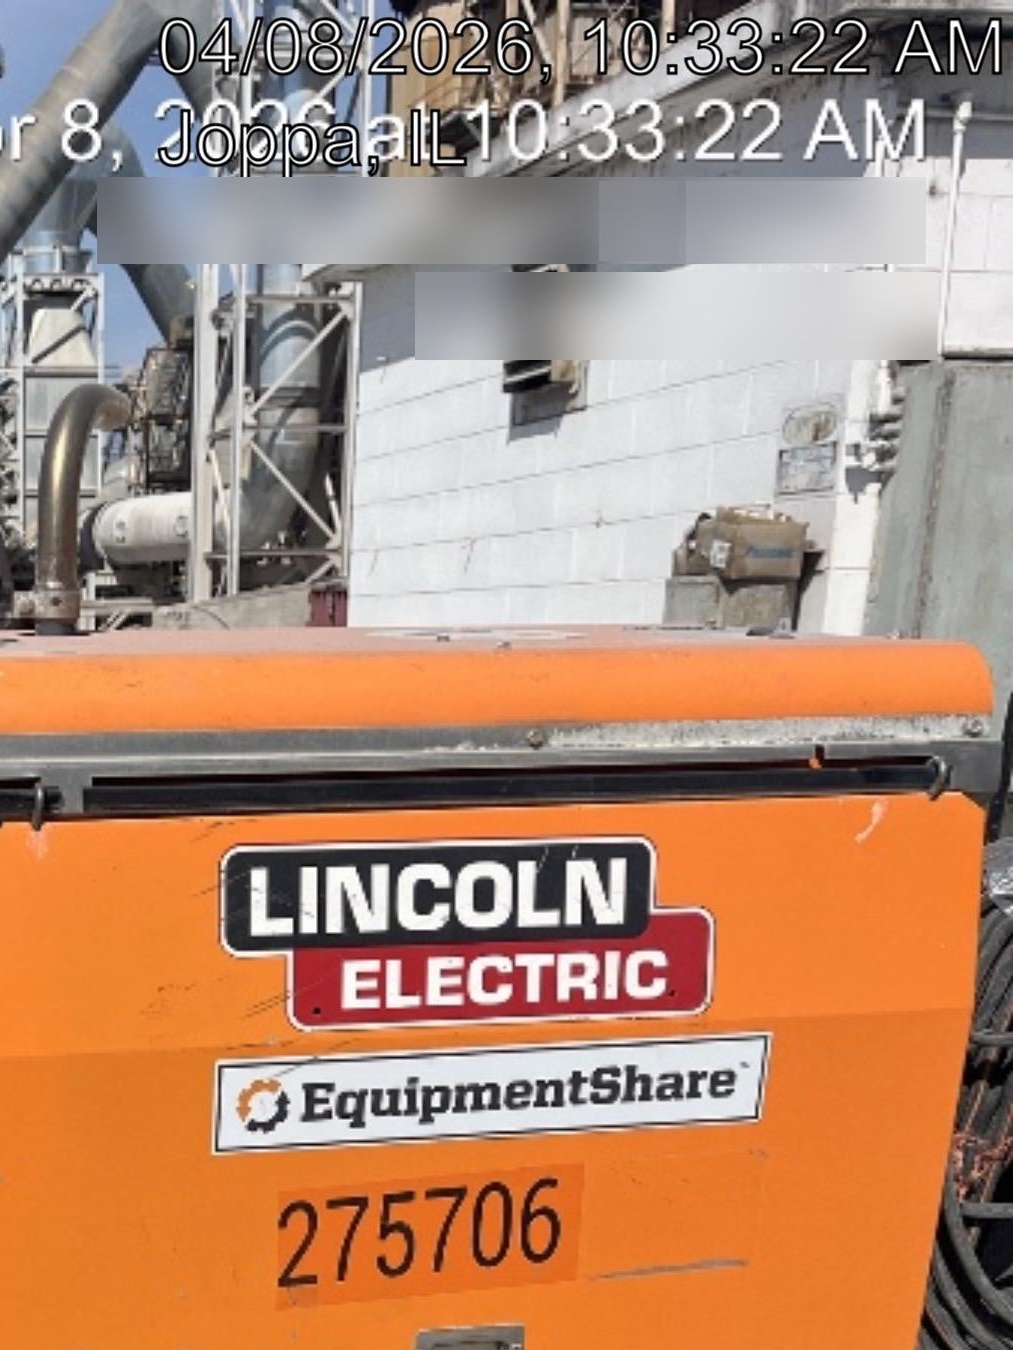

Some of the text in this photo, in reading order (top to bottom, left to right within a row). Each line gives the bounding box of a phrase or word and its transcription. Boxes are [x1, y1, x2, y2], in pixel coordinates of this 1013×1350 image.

[249, 857, 628, 938] LINCOLN
[339, 948, 670, 1010] ELECTRIC
[299, 1063, 738, 1129] EquipmentShare
[276, 1176, 563, 1290] 275706
